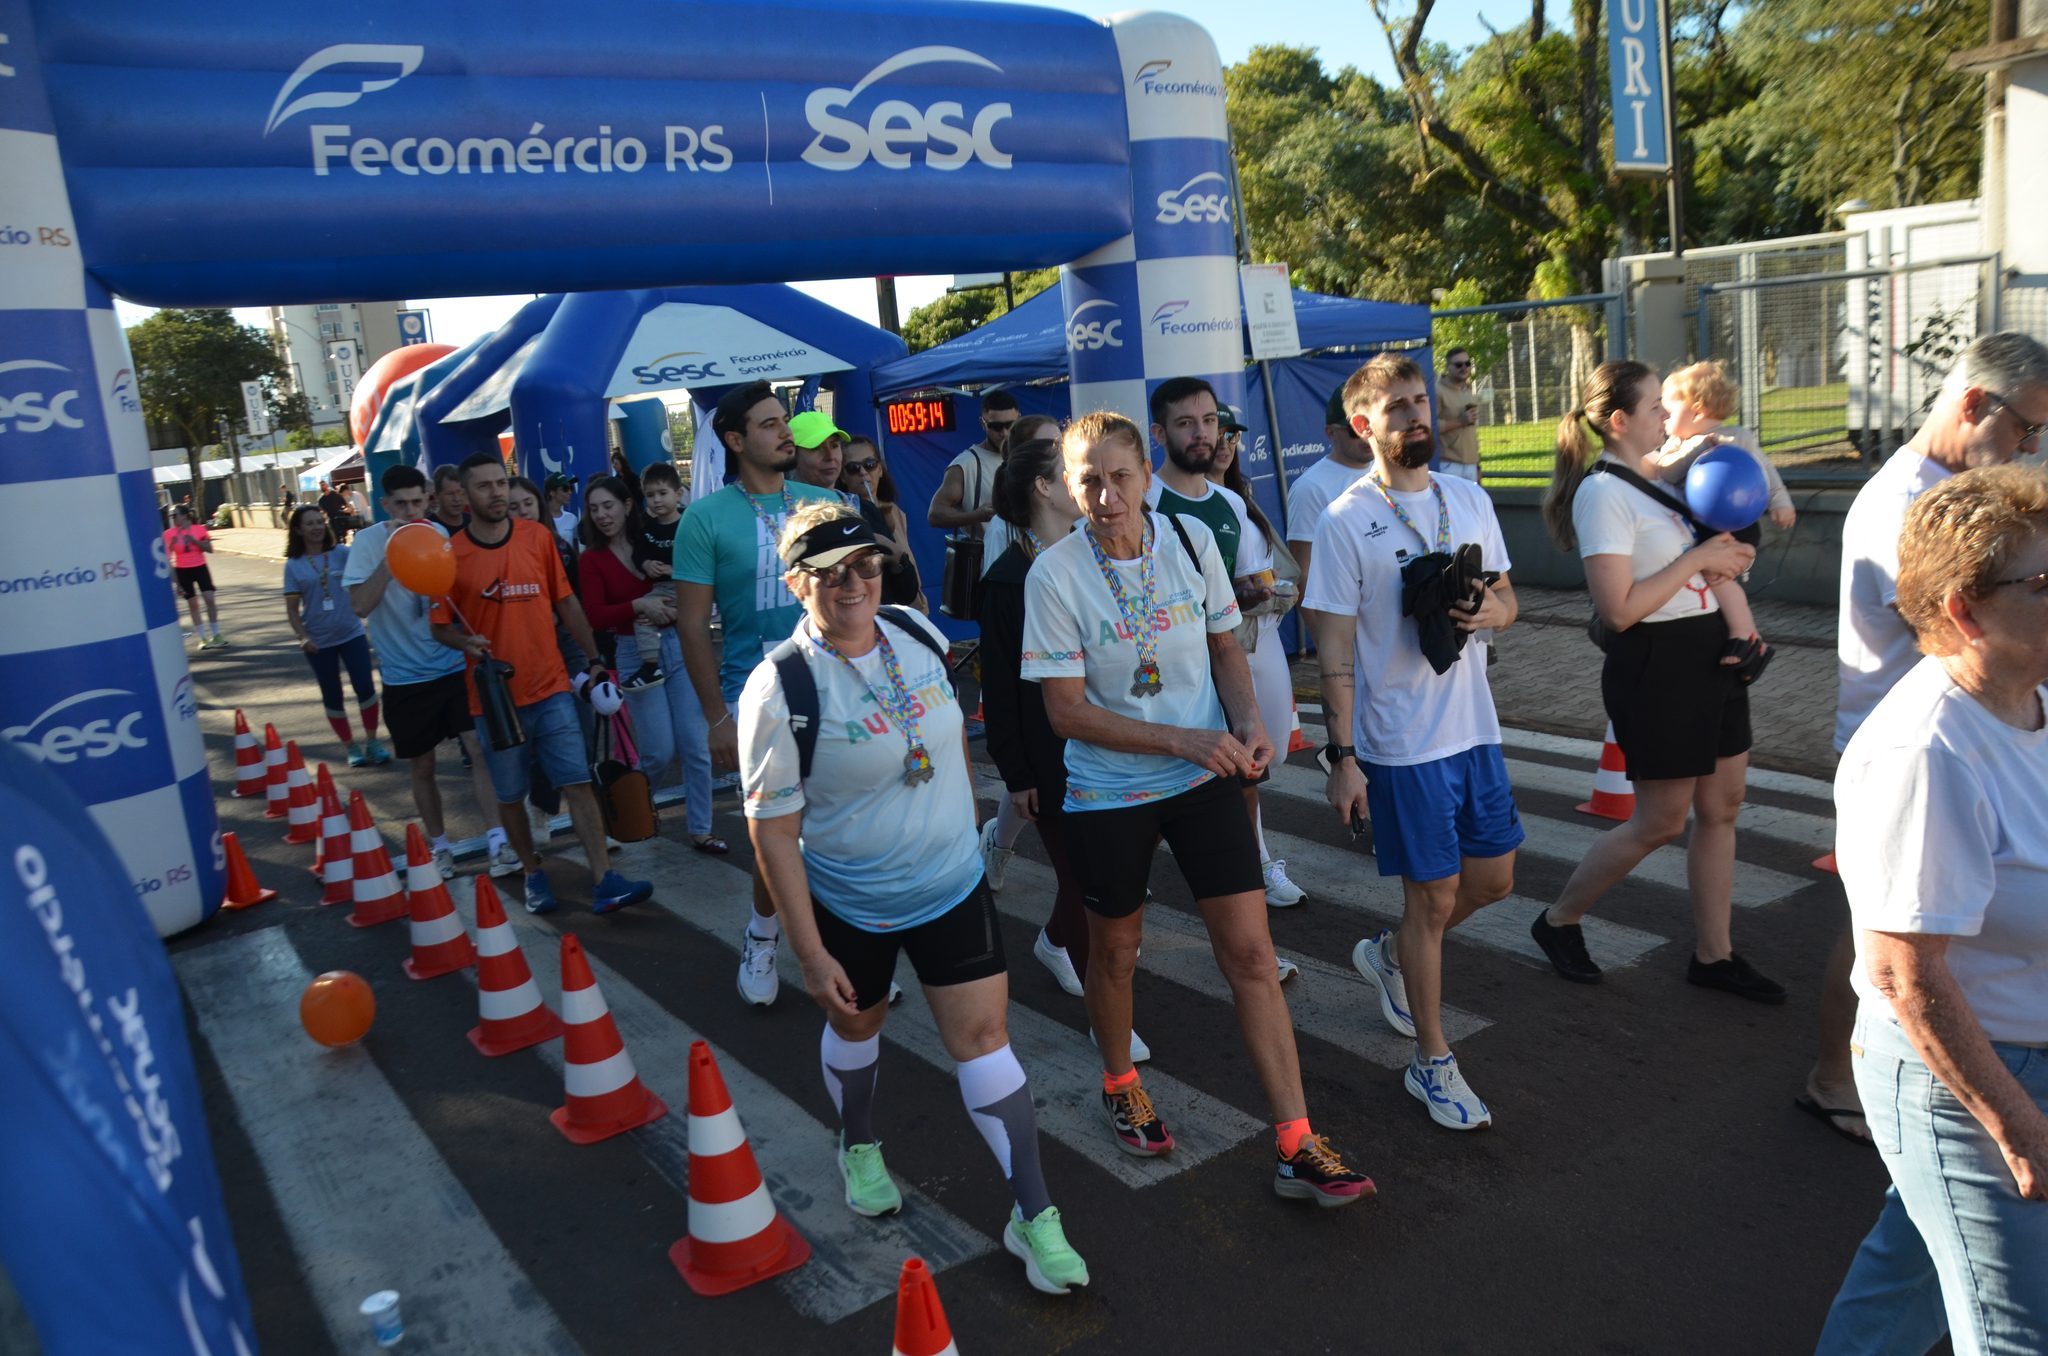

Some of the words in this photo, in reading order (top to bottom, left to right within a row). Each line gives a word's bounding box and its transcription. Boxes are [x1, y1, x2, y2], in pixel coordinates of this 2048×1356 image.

[1621, 0, 1652, 158] URI
[801, 86, 1013, 172] Sesc
[309, 122, 648, 176] Fecomércio
[664, 125, 734, 172] RS
[37, 227, 71, 247] RS
[729, 348, 807, 364] Fecomércio
[632, 361, 725, 385] Sesc
[738, 362, 781, 375] Senac
[888, 401, 945, 433] 00:59:14
[1281, 442, 1325, 457] ndicatos
[102, 561, 130, 580] RS
[166, 864, 192, 886] RS
